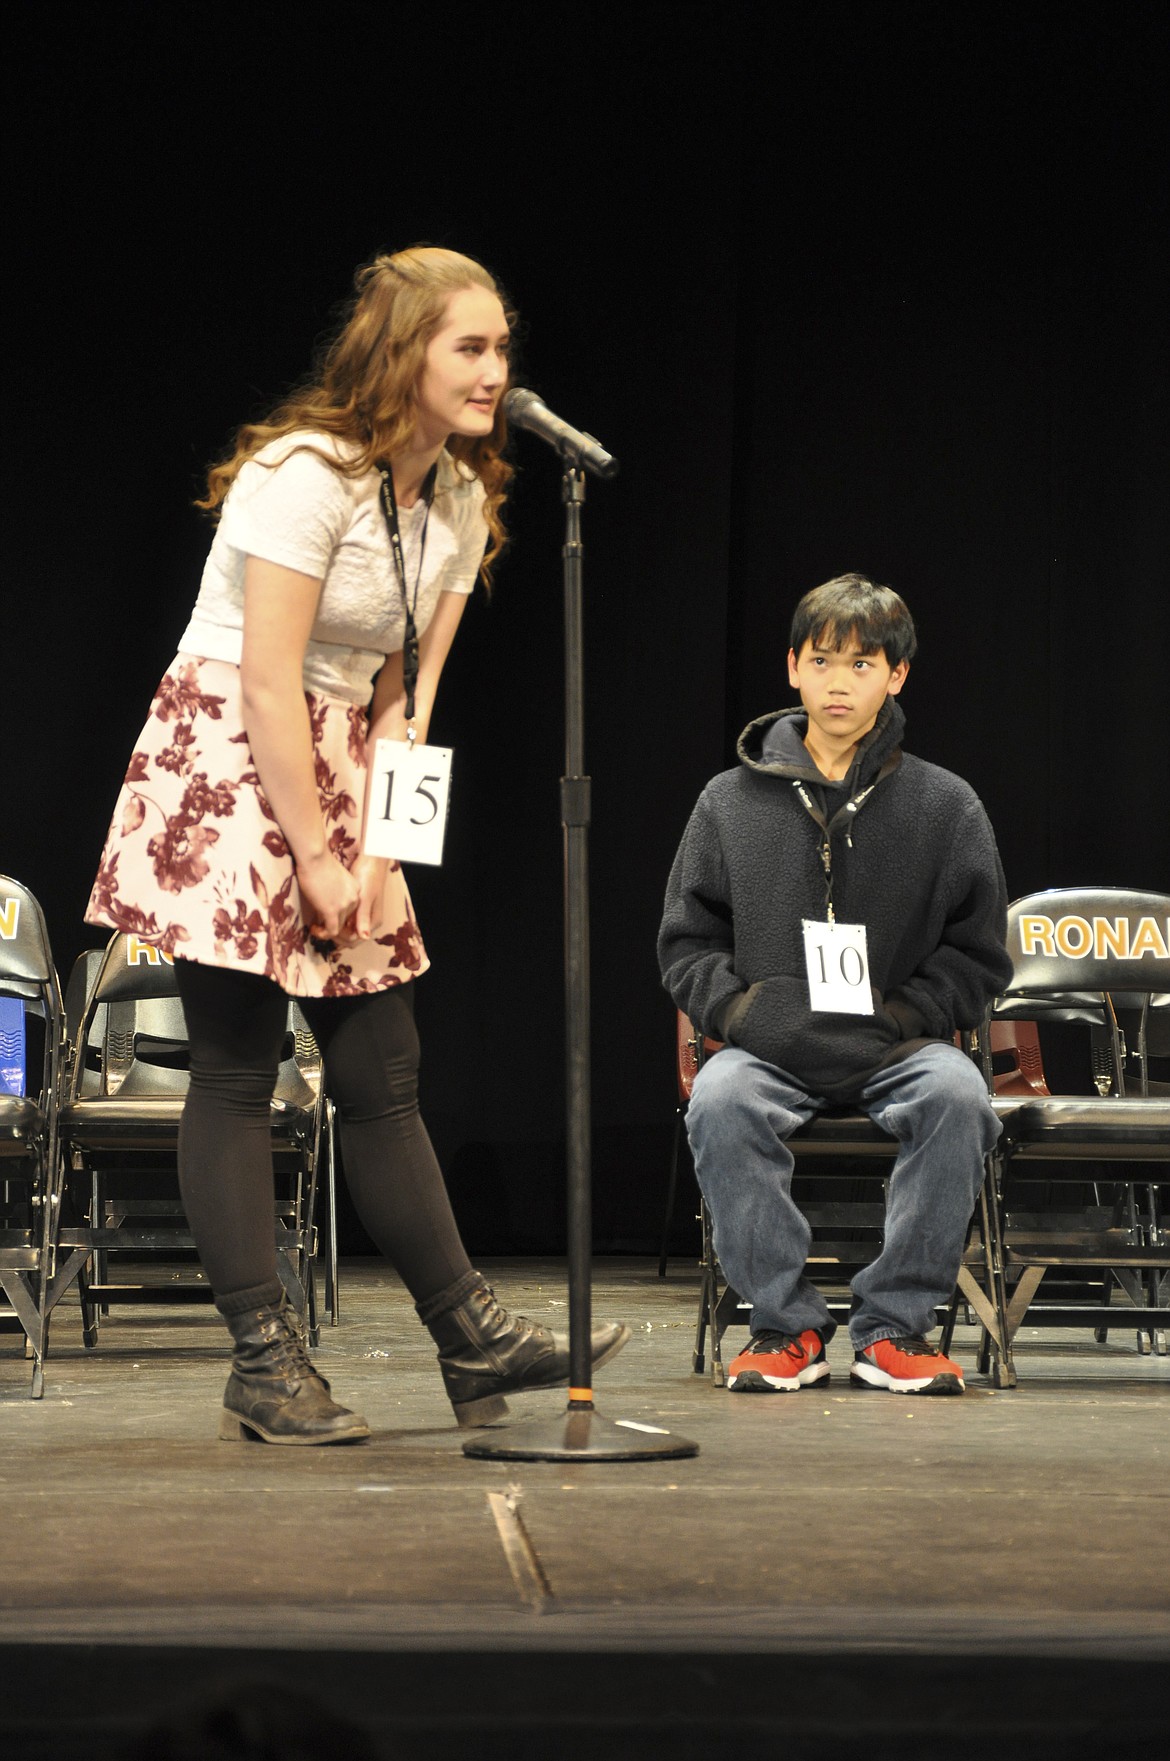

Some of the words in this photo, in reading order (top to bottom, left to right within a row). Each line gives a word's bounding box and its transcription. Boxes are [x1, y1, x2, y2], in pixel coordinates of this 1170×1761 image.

[378, 769, 441, 825] 15
[1019, 915, 1170, 959] RONA
[816, 945, 864, 986] 10
